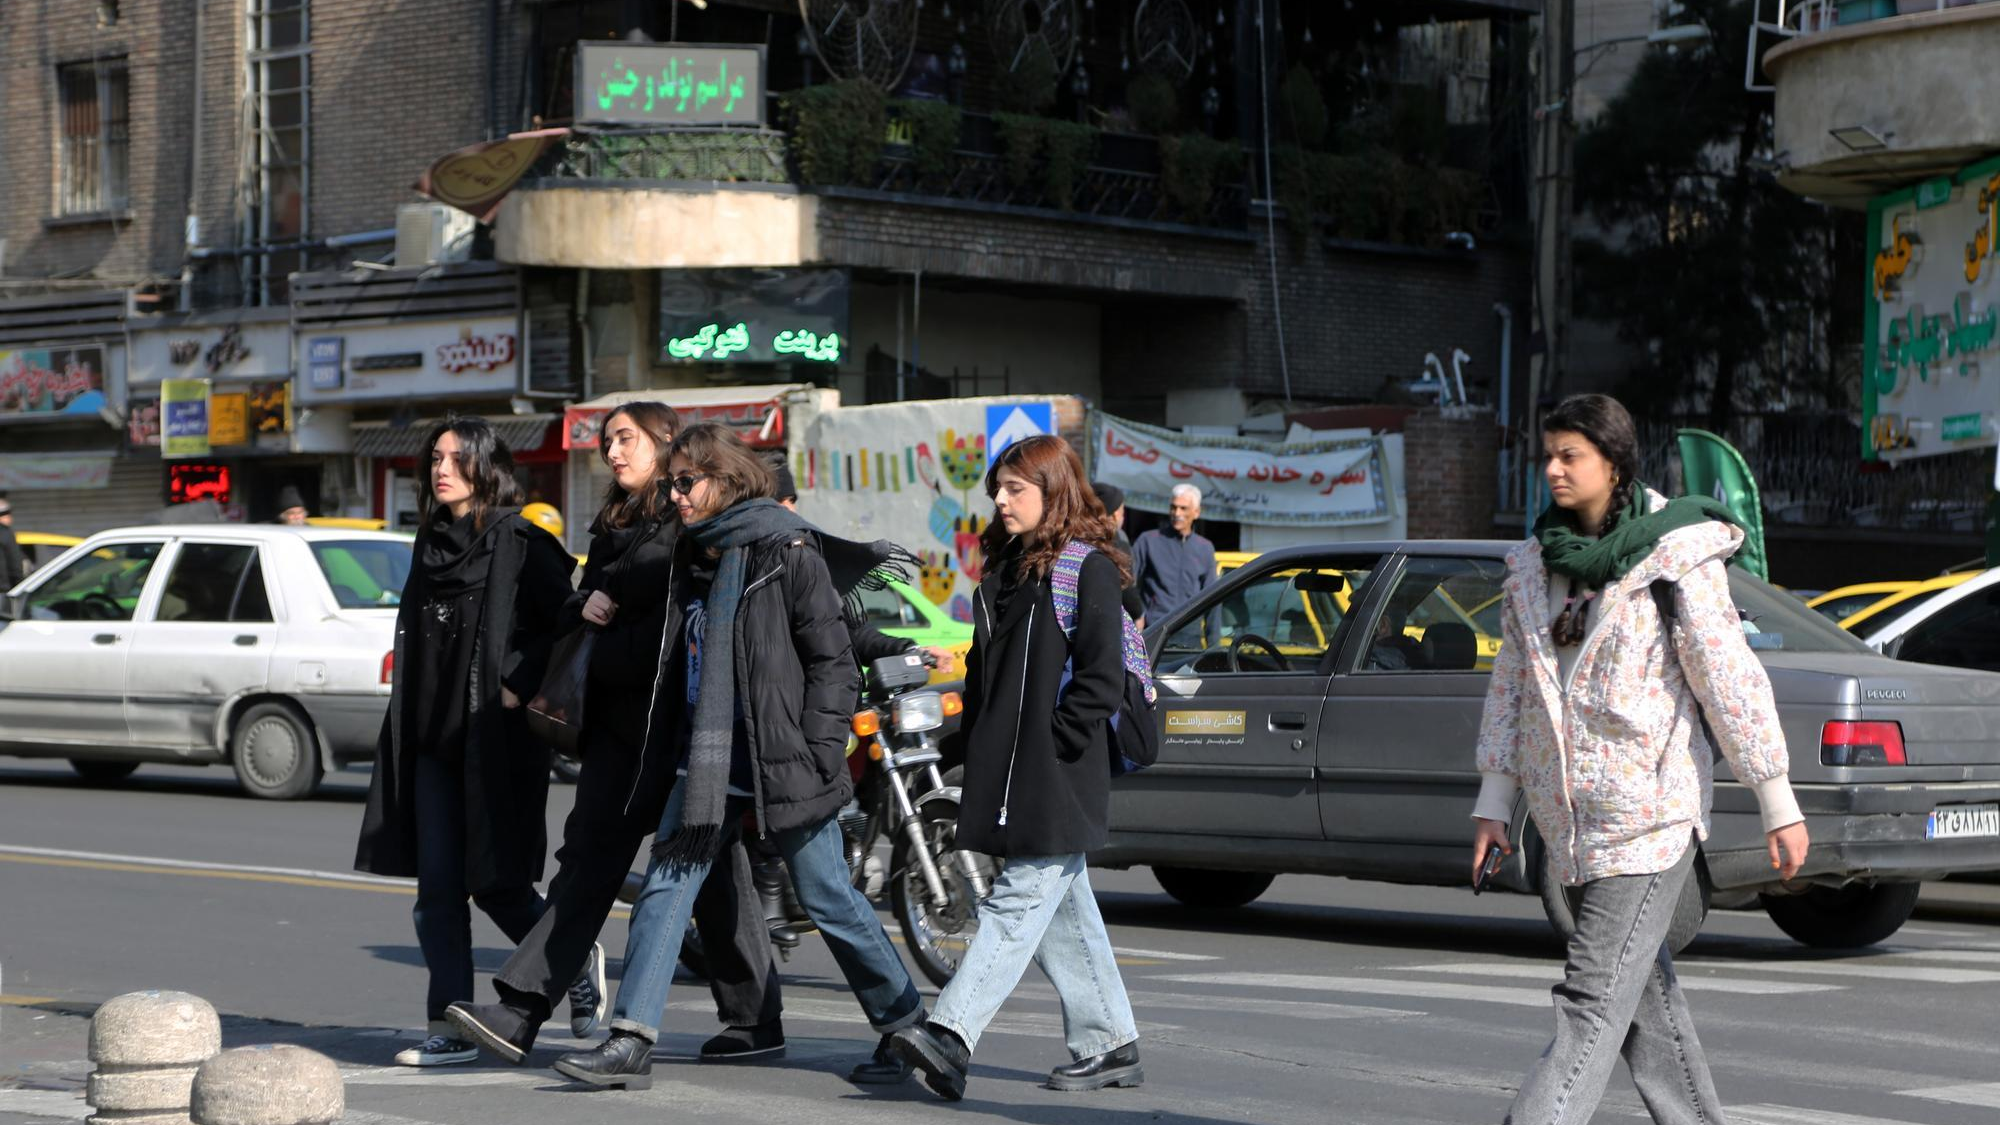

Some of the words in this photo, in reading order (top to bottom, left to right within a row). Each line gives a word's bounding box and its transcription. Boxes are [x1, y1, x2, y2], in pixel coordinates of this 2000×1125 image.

[597, 57, 640, 111] جشن
[643, 75, 655, 112] و
[658, 56, 694, 113] تولد
[695, 56, 745, 113] مراسم
[668, 322, 750, 359] فتوکپی
[773, 329, 840, 361] پرینت
[1168, 459, 1237, 480] سنتی
[1246, 463, 1302, 484] خانه
[1309, 464, 1366, 495] سفره
[1865, 689, 1907, 700] PEUGEOT
[1168, 714, 1211, 728] سراست
[1213, 713, 1242, 728] کاشی
